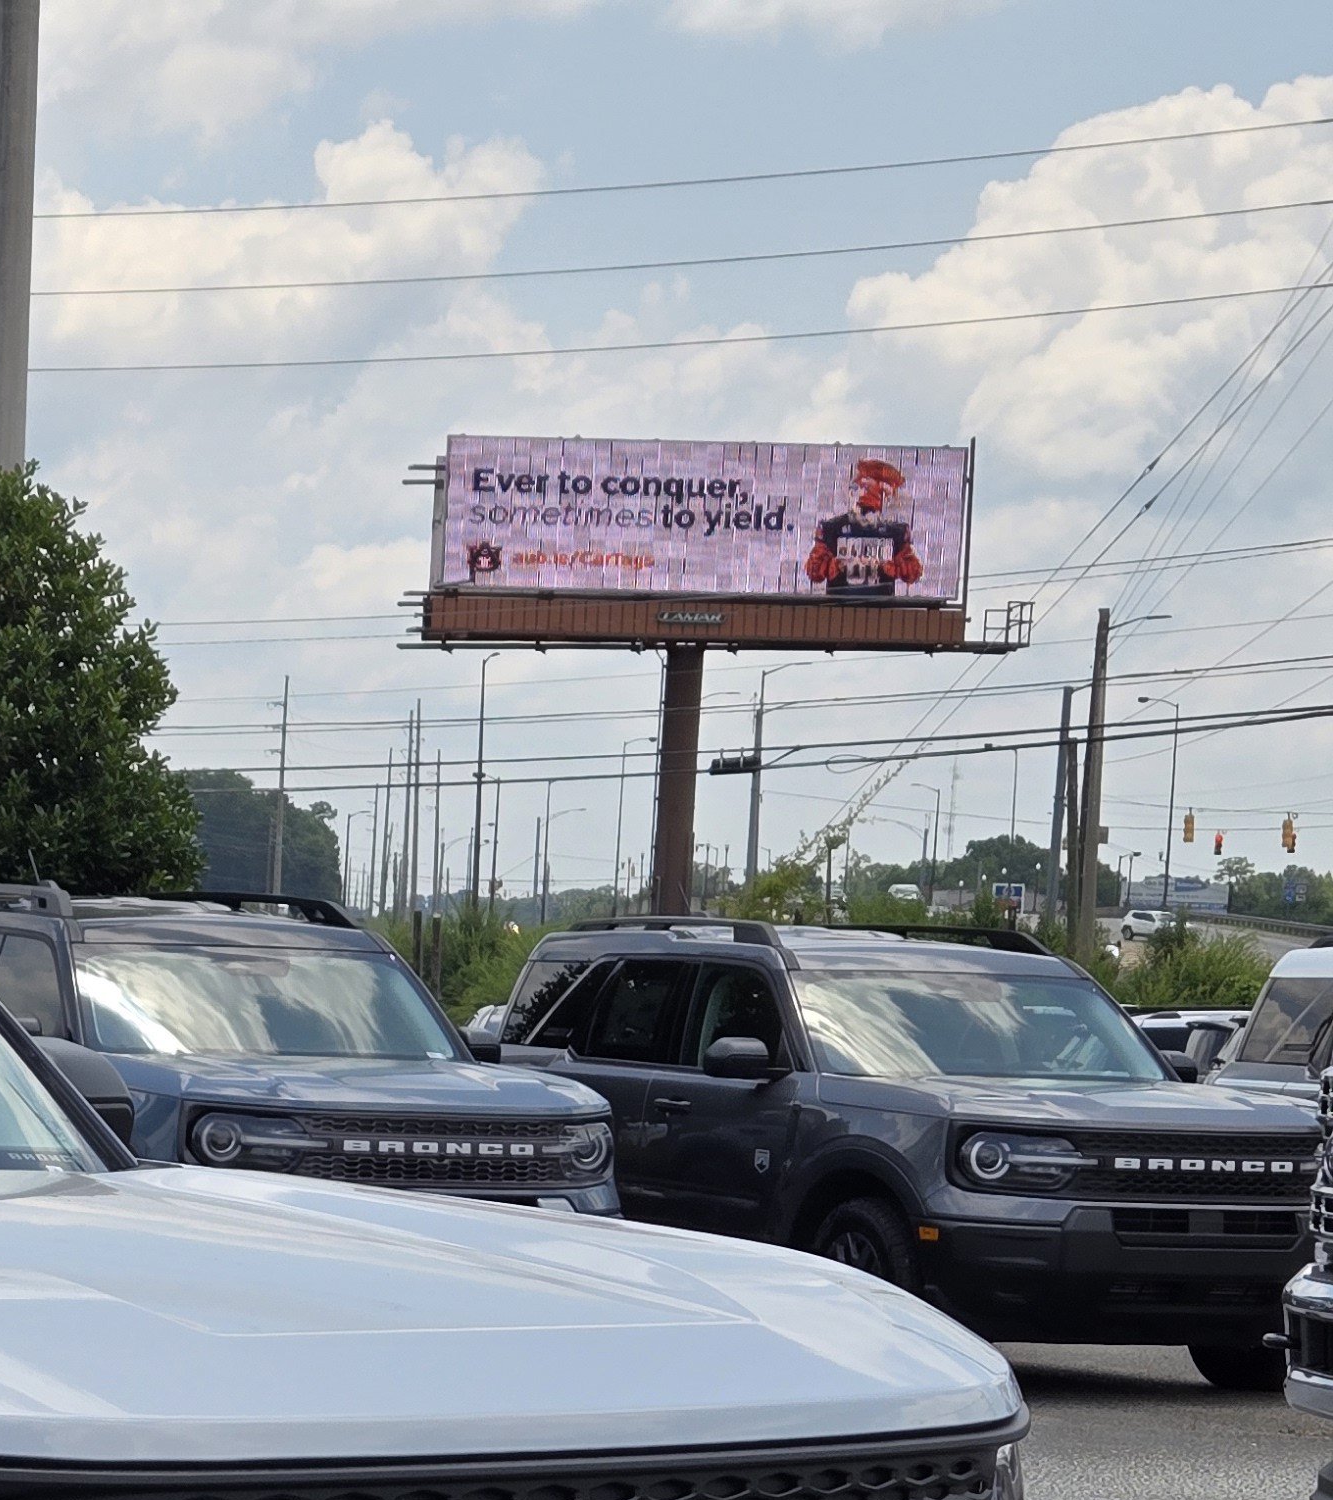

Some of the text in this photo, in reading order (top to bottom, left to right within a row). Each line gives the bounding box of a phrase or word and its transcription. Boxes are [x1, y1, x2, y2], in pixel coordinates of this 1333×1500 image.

[472, 467, 749, 504] Ever to conquer,
[468, 502, 794, 537] sometimes to yield.
[662, 611, 722, 623] LAMAR
[343, 1139, 535, 1156] BRONCO
[1114, 1157, 1294, 1173] BRONCO
